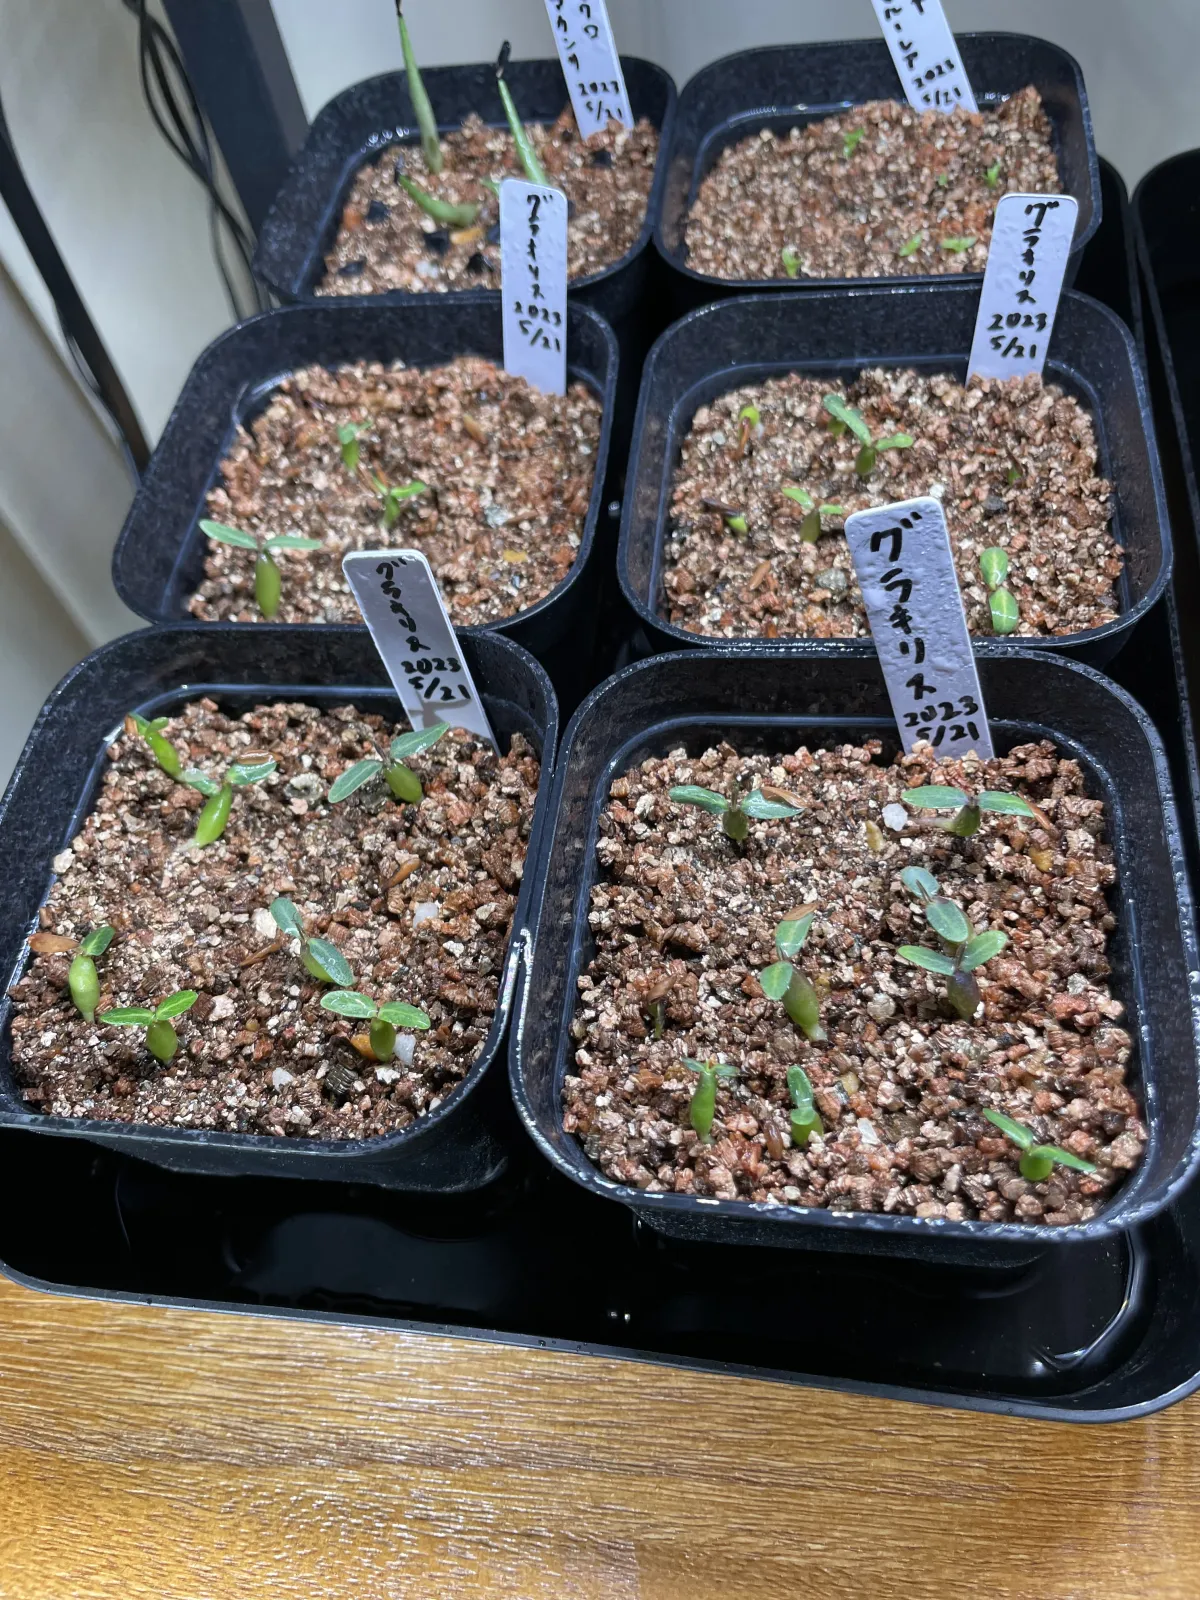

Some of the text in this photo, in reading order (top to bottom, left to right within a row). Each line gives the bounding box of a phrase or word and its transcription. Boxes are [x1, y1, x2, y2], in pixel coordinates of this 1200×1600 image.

[526, 194, 554, 300] グラキリス
[1015, 200, 1060, 305] グラキリス
[513, 301, 562, 326] 2023
[986, 312, 1048, 333] 2023
[518, 319, 561, 352] 5/21
[990, 334, 1037, 359] 5/21
[375, 556, 432, 653] グラキリス
[869, 511, 937, 700] グラキリス
[401, 657, 462, 675] 2023
[408, 676, 472, 701] 5/21
[903, 695, 979, 728] 2023
[915, 721, 980, 747] 5/21
